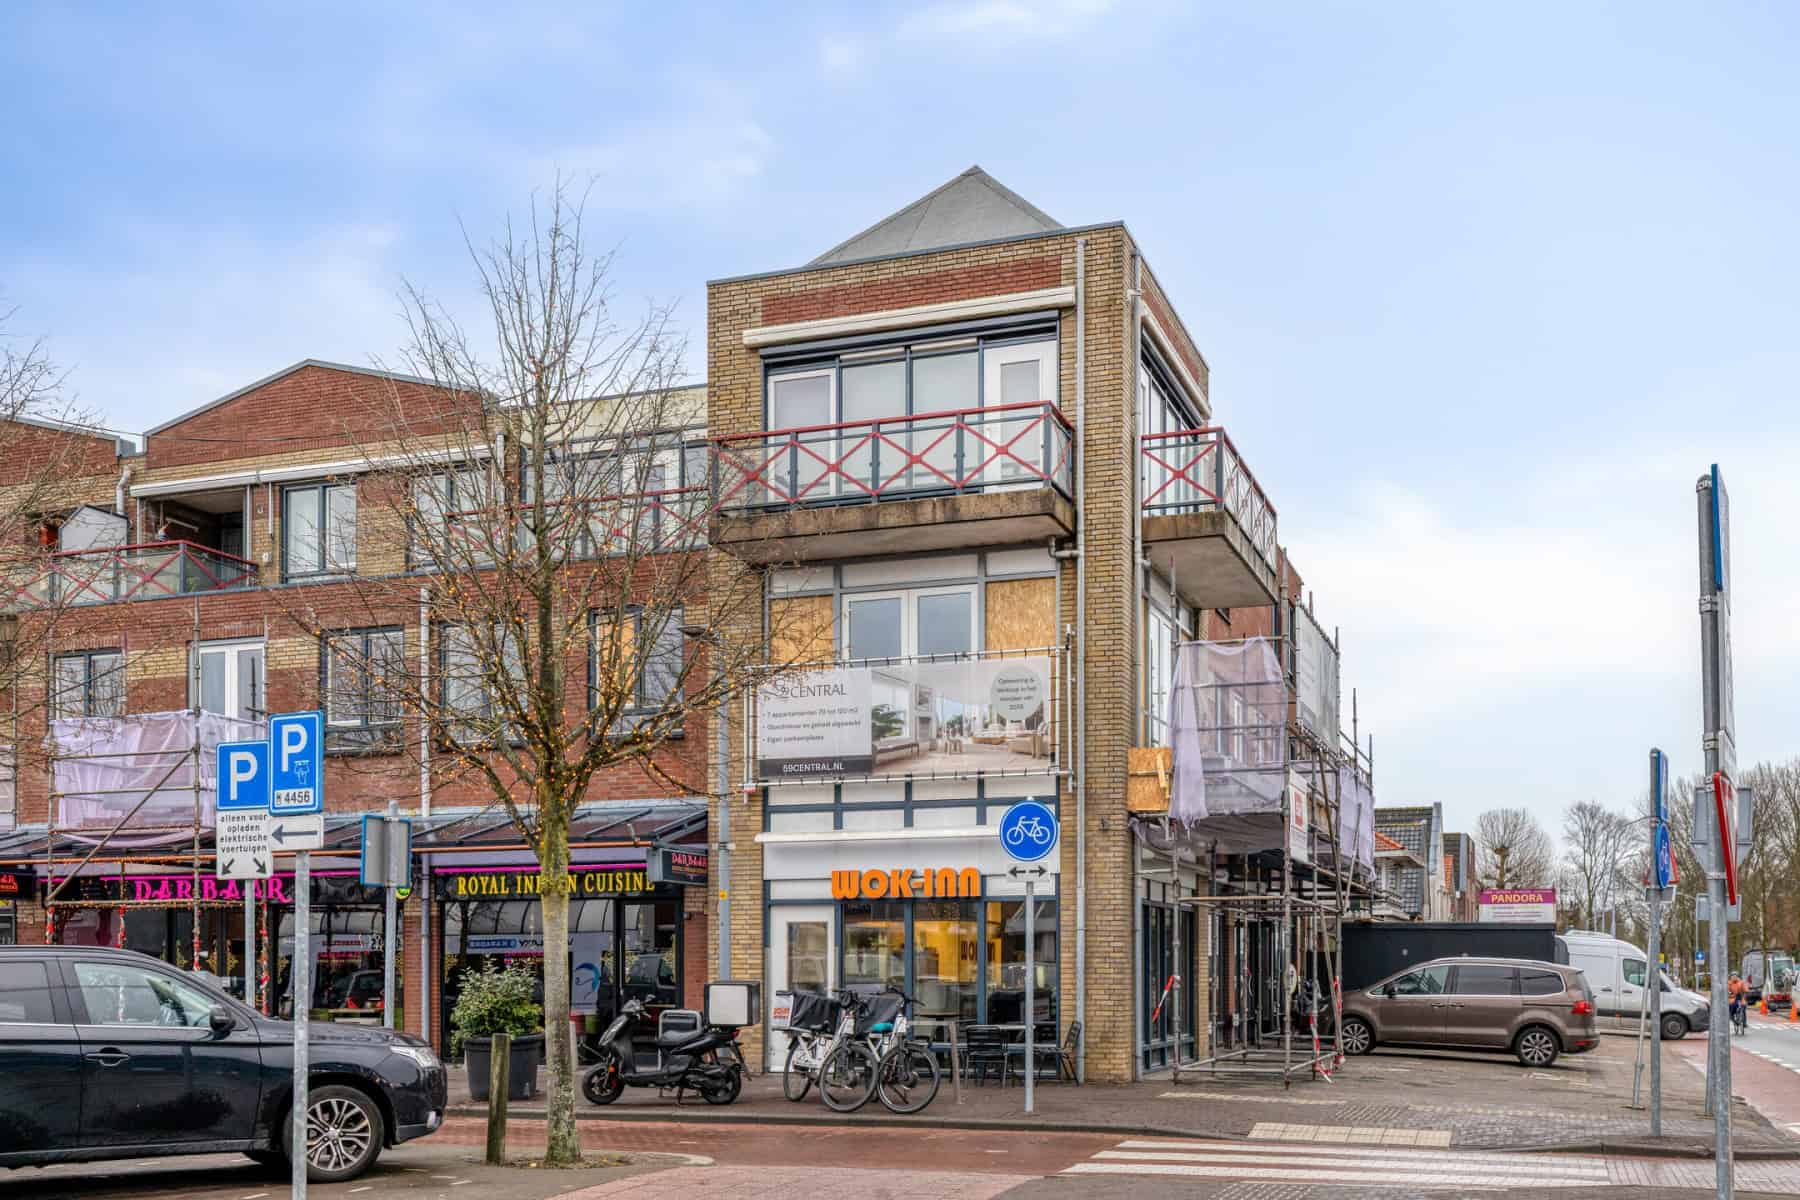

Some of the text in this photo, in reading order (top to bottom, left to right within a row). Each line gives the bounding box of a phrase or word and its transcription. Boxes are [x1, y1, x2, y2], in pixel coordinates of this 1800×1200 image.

[282, 724, 308, 772] P
[230, 752, 257, 800] P
[220, 814, 267, 823] alleen voor
[227, 824, 261, 833] opladen
[220, 834, 268, 843] elektrische
[220, 844, 267, 854] voertuigen
[457, 875, 510, 895] ROYAL
[516, 874, 577, 894] INN
[1491, 894, 1543, 904] PANDORA
